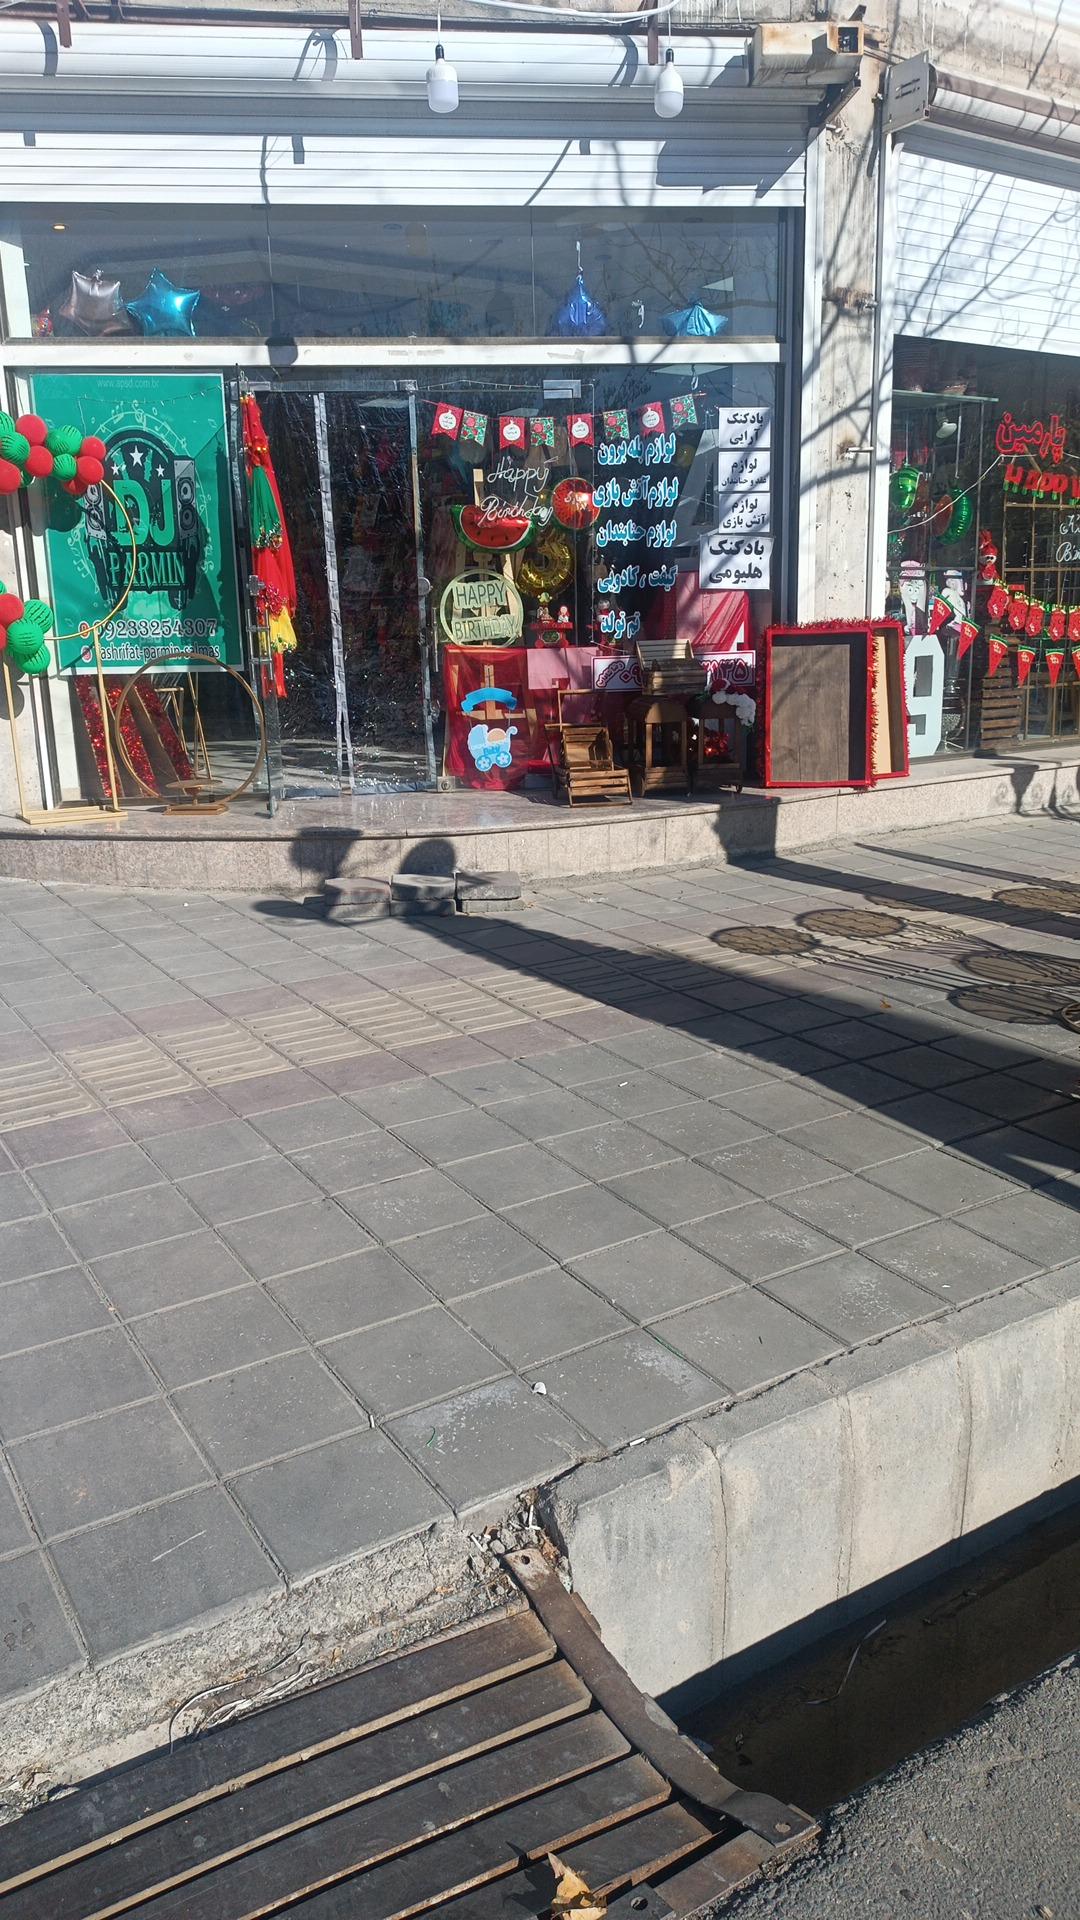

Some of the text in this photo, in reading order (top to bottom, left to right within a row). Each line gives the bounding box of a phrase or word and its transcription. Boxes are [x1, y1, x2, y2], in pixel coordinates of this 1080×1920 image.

[727, 412, 764, 427] بادکنک
[646, 432, 677, 466] لوازم
[729, 428, 760, 446] آرایی
[996, 412, 1067, 464] پارمین
[597, 440, 628, 466] برون
[487, 455, 559, 493] Happy
[731, 458, 758, 474] لوازم
[592, 475, 679, 510] لوازم آتش بازی
[721, 476, 749, 488] حنابندان
[112, 479, 175, 546] DJ
[477, 494, 554, 528] Birthday
[731, 498, 758, 513] لوازم
[596, 519, 677, 548] لوازم حنابندان
[722, 513, 766, 529] آتش بازی
[709, 538, 765, 560] بادکنک
[108, 551, 186, 588] PARMIN
[708, 562, 763, 584] هلیومی
[454, 582, 506, 606] HAPPY
[453, 615, 517, 640] BIRTHDAY
[600, 610, 641, 639] تم تولد
[97, 641, 221, 664] ashrifat-parmin-salmas
